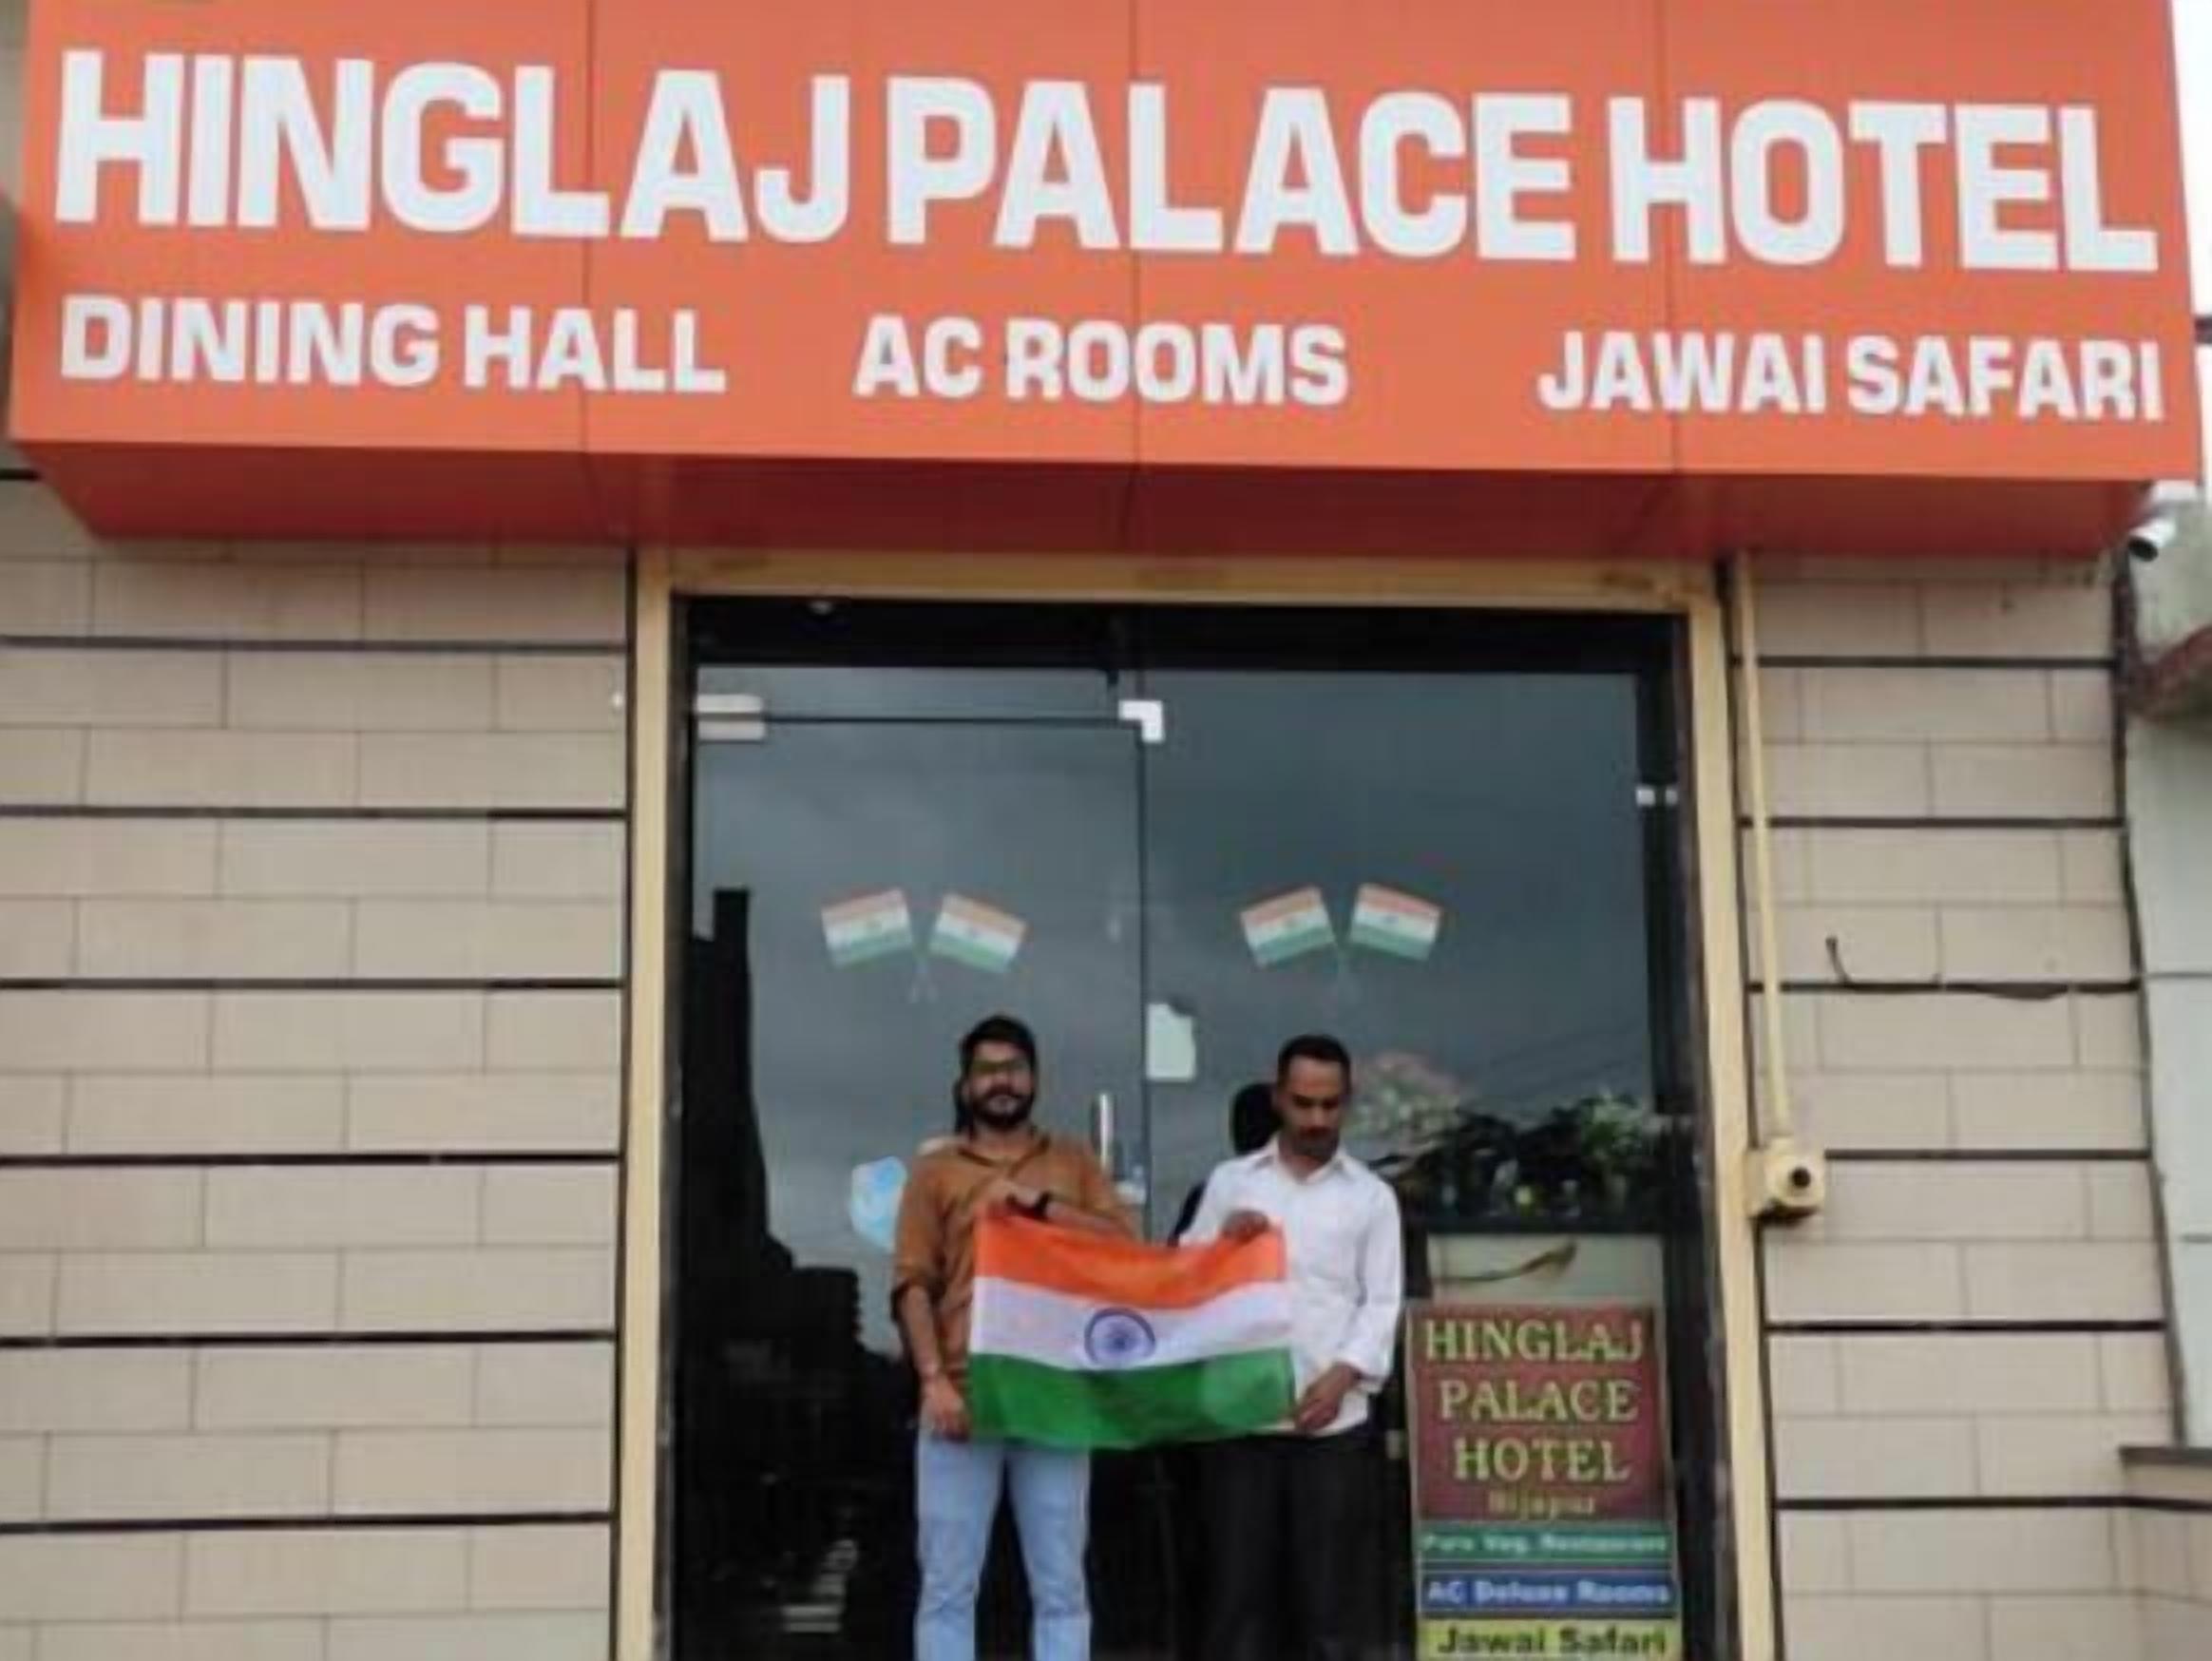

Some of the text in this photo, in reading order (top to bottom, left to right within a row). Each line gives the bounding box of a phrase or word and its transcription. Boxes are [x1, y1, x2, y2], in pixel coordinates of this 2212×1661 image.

[55, 49, 2158, 272] HINGLAJ PALACE HOTEL
[62, 296, 725, 392] DINING HALL
[854, 315, 1348, 405] AC ROOMS
[1538, 331, 2163, 420] JAWAI SAFARI
[1425, 1319, 1645, 1361] HINGLAJ
[1440, 1379, 1638, 1421] PALACE
[1454, 1438, 1630, 1481] HOTEL
[1428, 1580, 1464, 1604] AC
[1437, 1625, 1667, 1654] Jawai Safari
